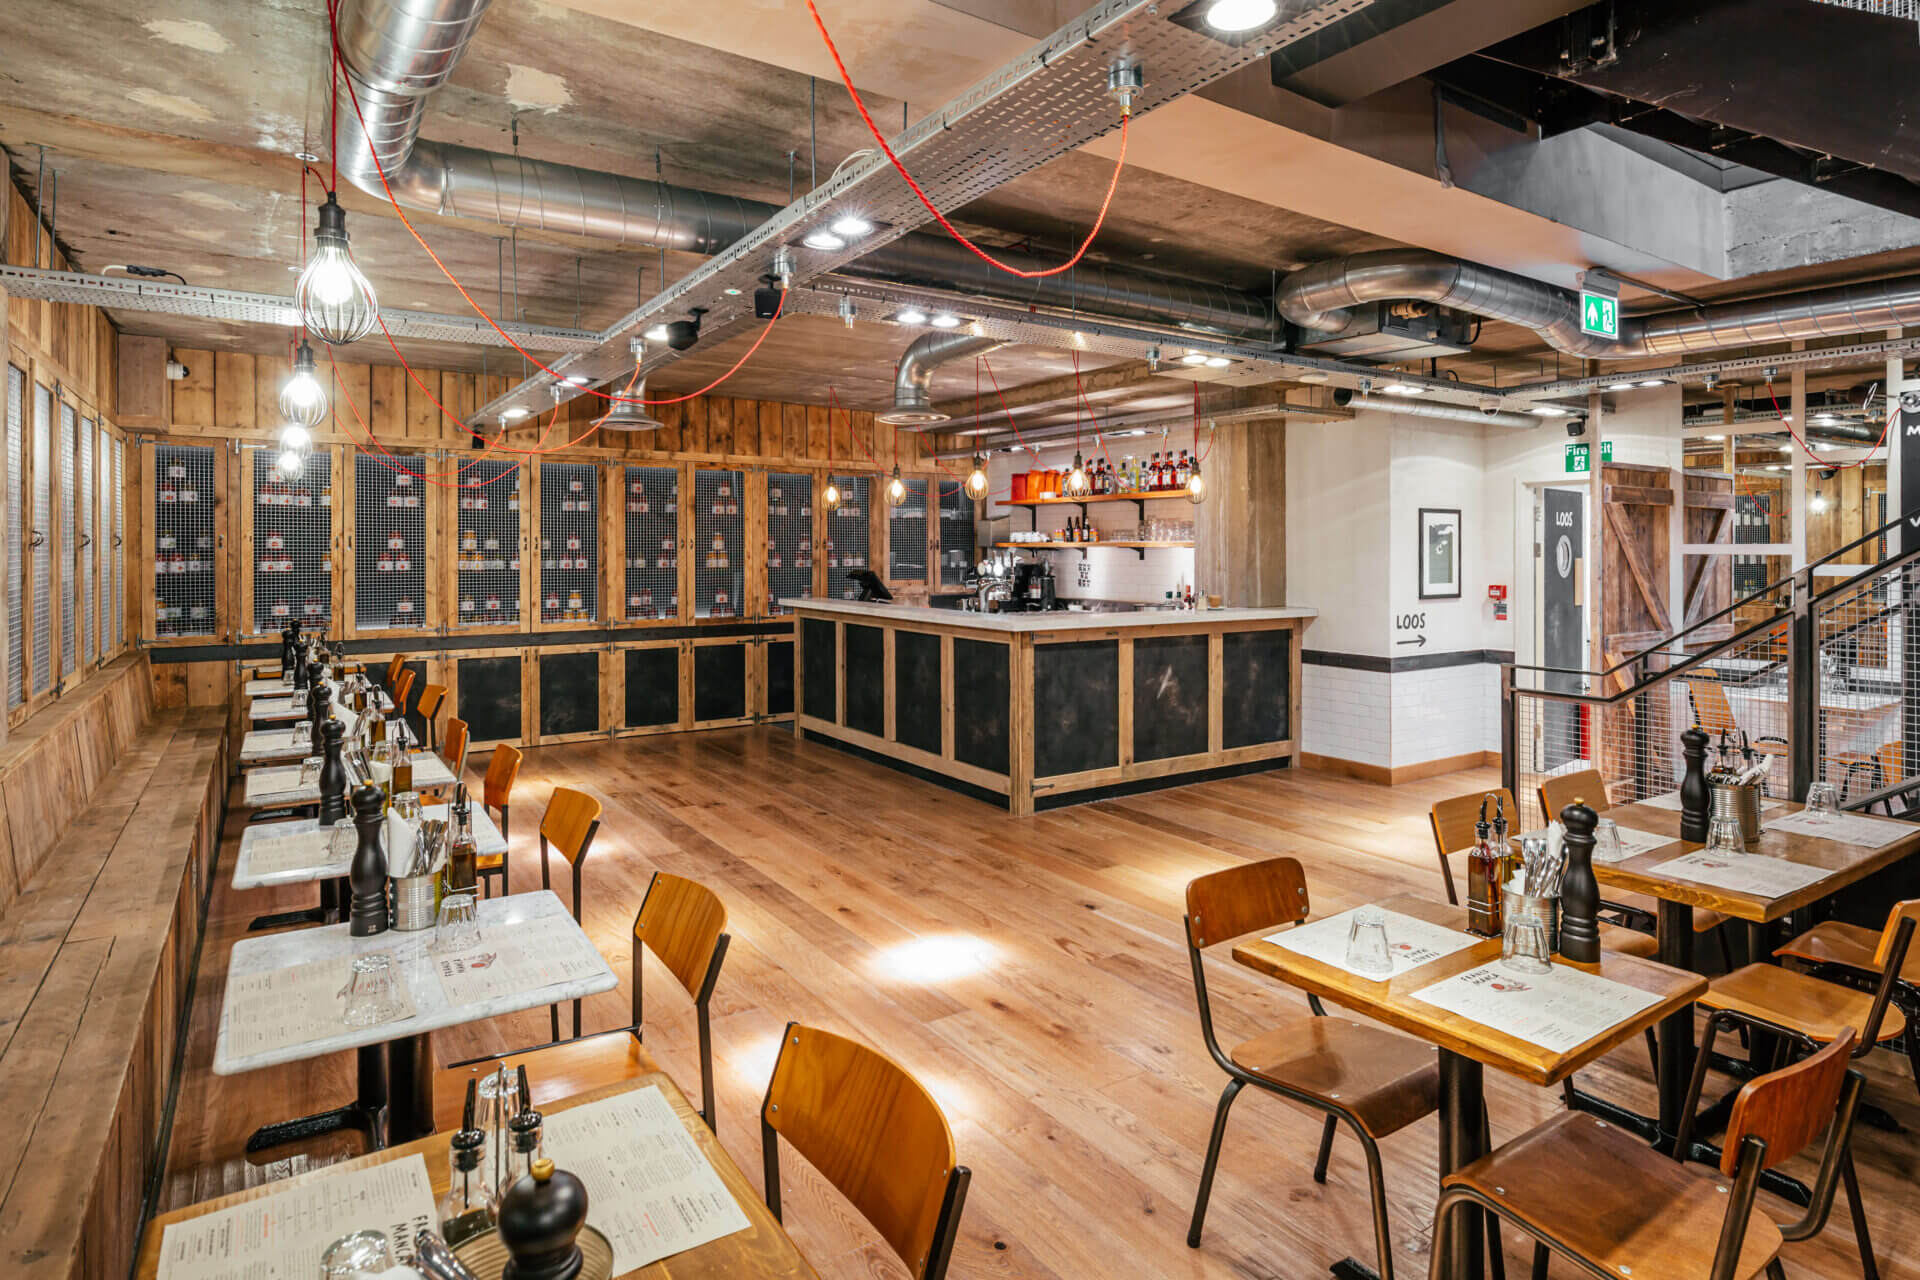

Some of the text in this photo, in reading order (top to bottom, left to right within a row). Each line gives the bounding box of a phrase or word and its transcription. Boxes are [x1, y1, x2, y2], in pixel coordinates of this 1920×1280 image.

[1566, 446, 1588, 456] Fire
[1555, 511, 1573, 527] LOOS
[1396, 612, 1426, 630] LOOS
